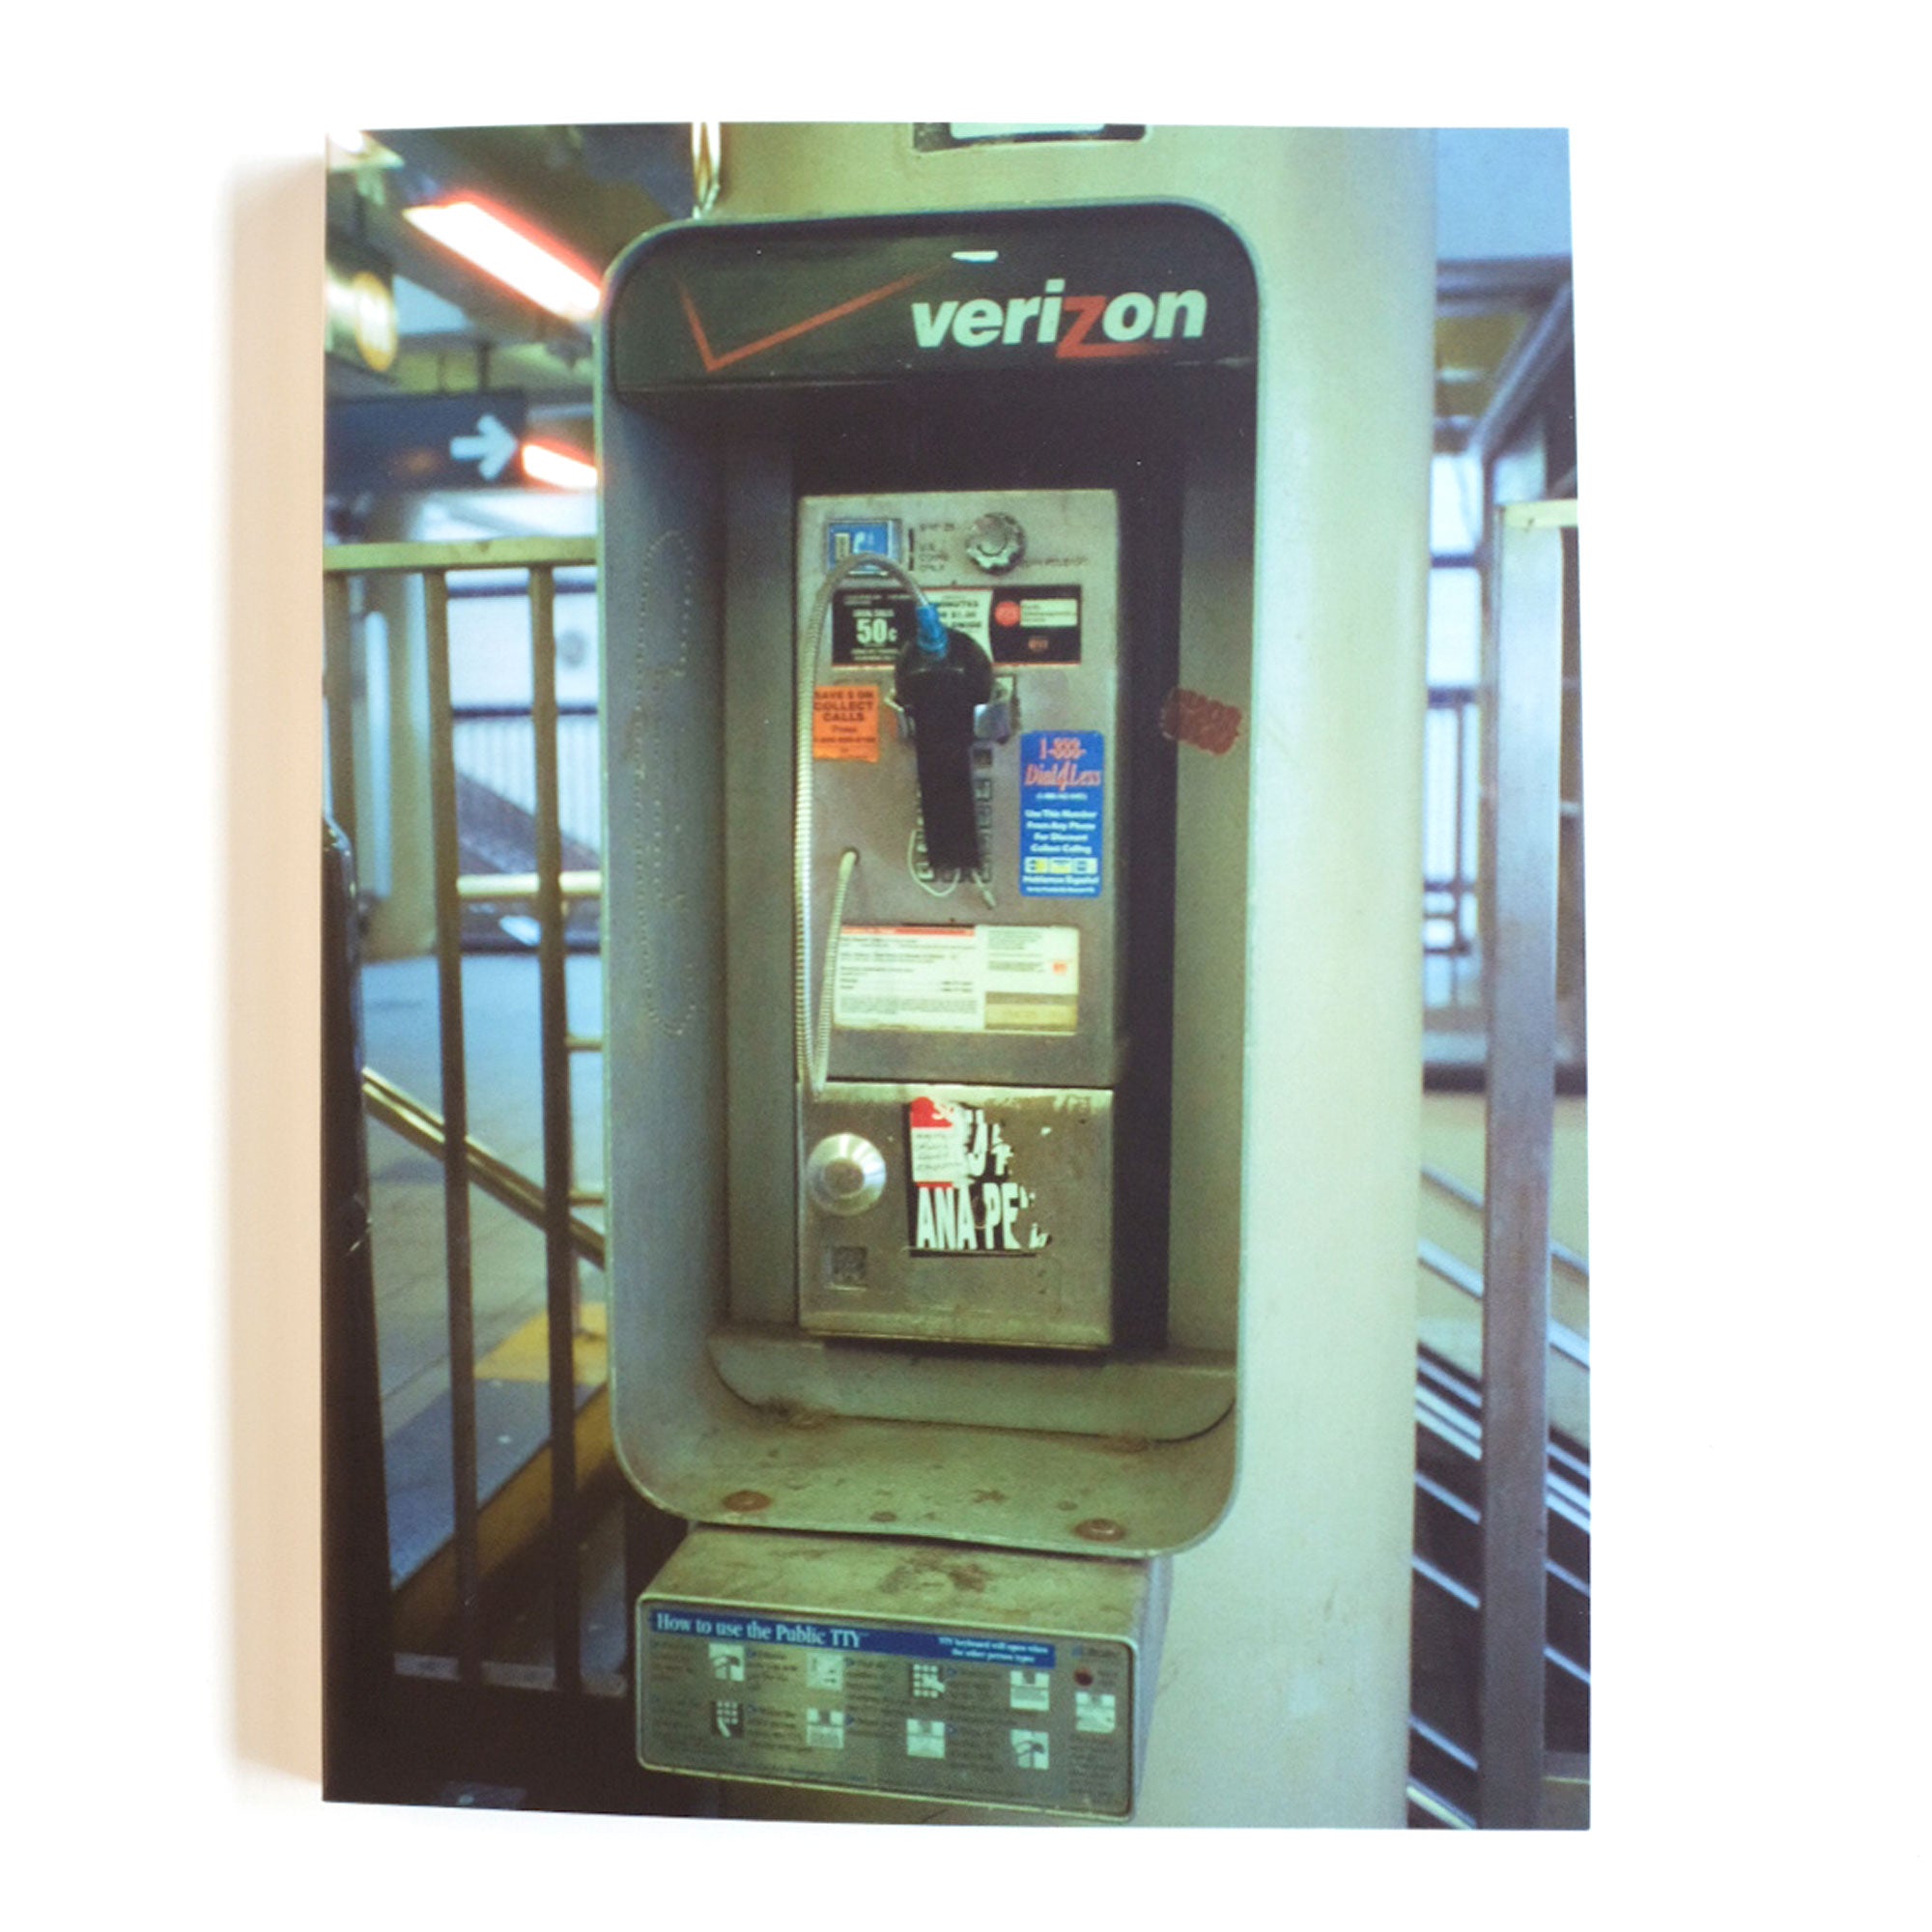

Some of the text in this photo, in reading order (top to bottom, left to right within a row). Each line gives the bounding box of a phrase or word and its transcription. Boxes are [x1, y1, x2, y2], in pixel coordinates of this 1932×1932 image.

[911, 277, 1208, 358] verizon
[813, 700, 873, 711] COLLECT
[823, 712, 865, 723] CALLS
[1062, 810, 1097, 819] Number
[916, 1185, 978, 1250] ANA
[656, 1612, 692, 1632] How
[696, 1618, 712, 1634] to
[716, 1622, 743, 1638] use
[747, 1621, 772, 1640] the
[776, 1624, 826, 1644] Public
[954, 1637, 990, 1649] keyboard
[991, 1641, 1006, 1650] will
[1007, 1644, 1026, 1653] open
